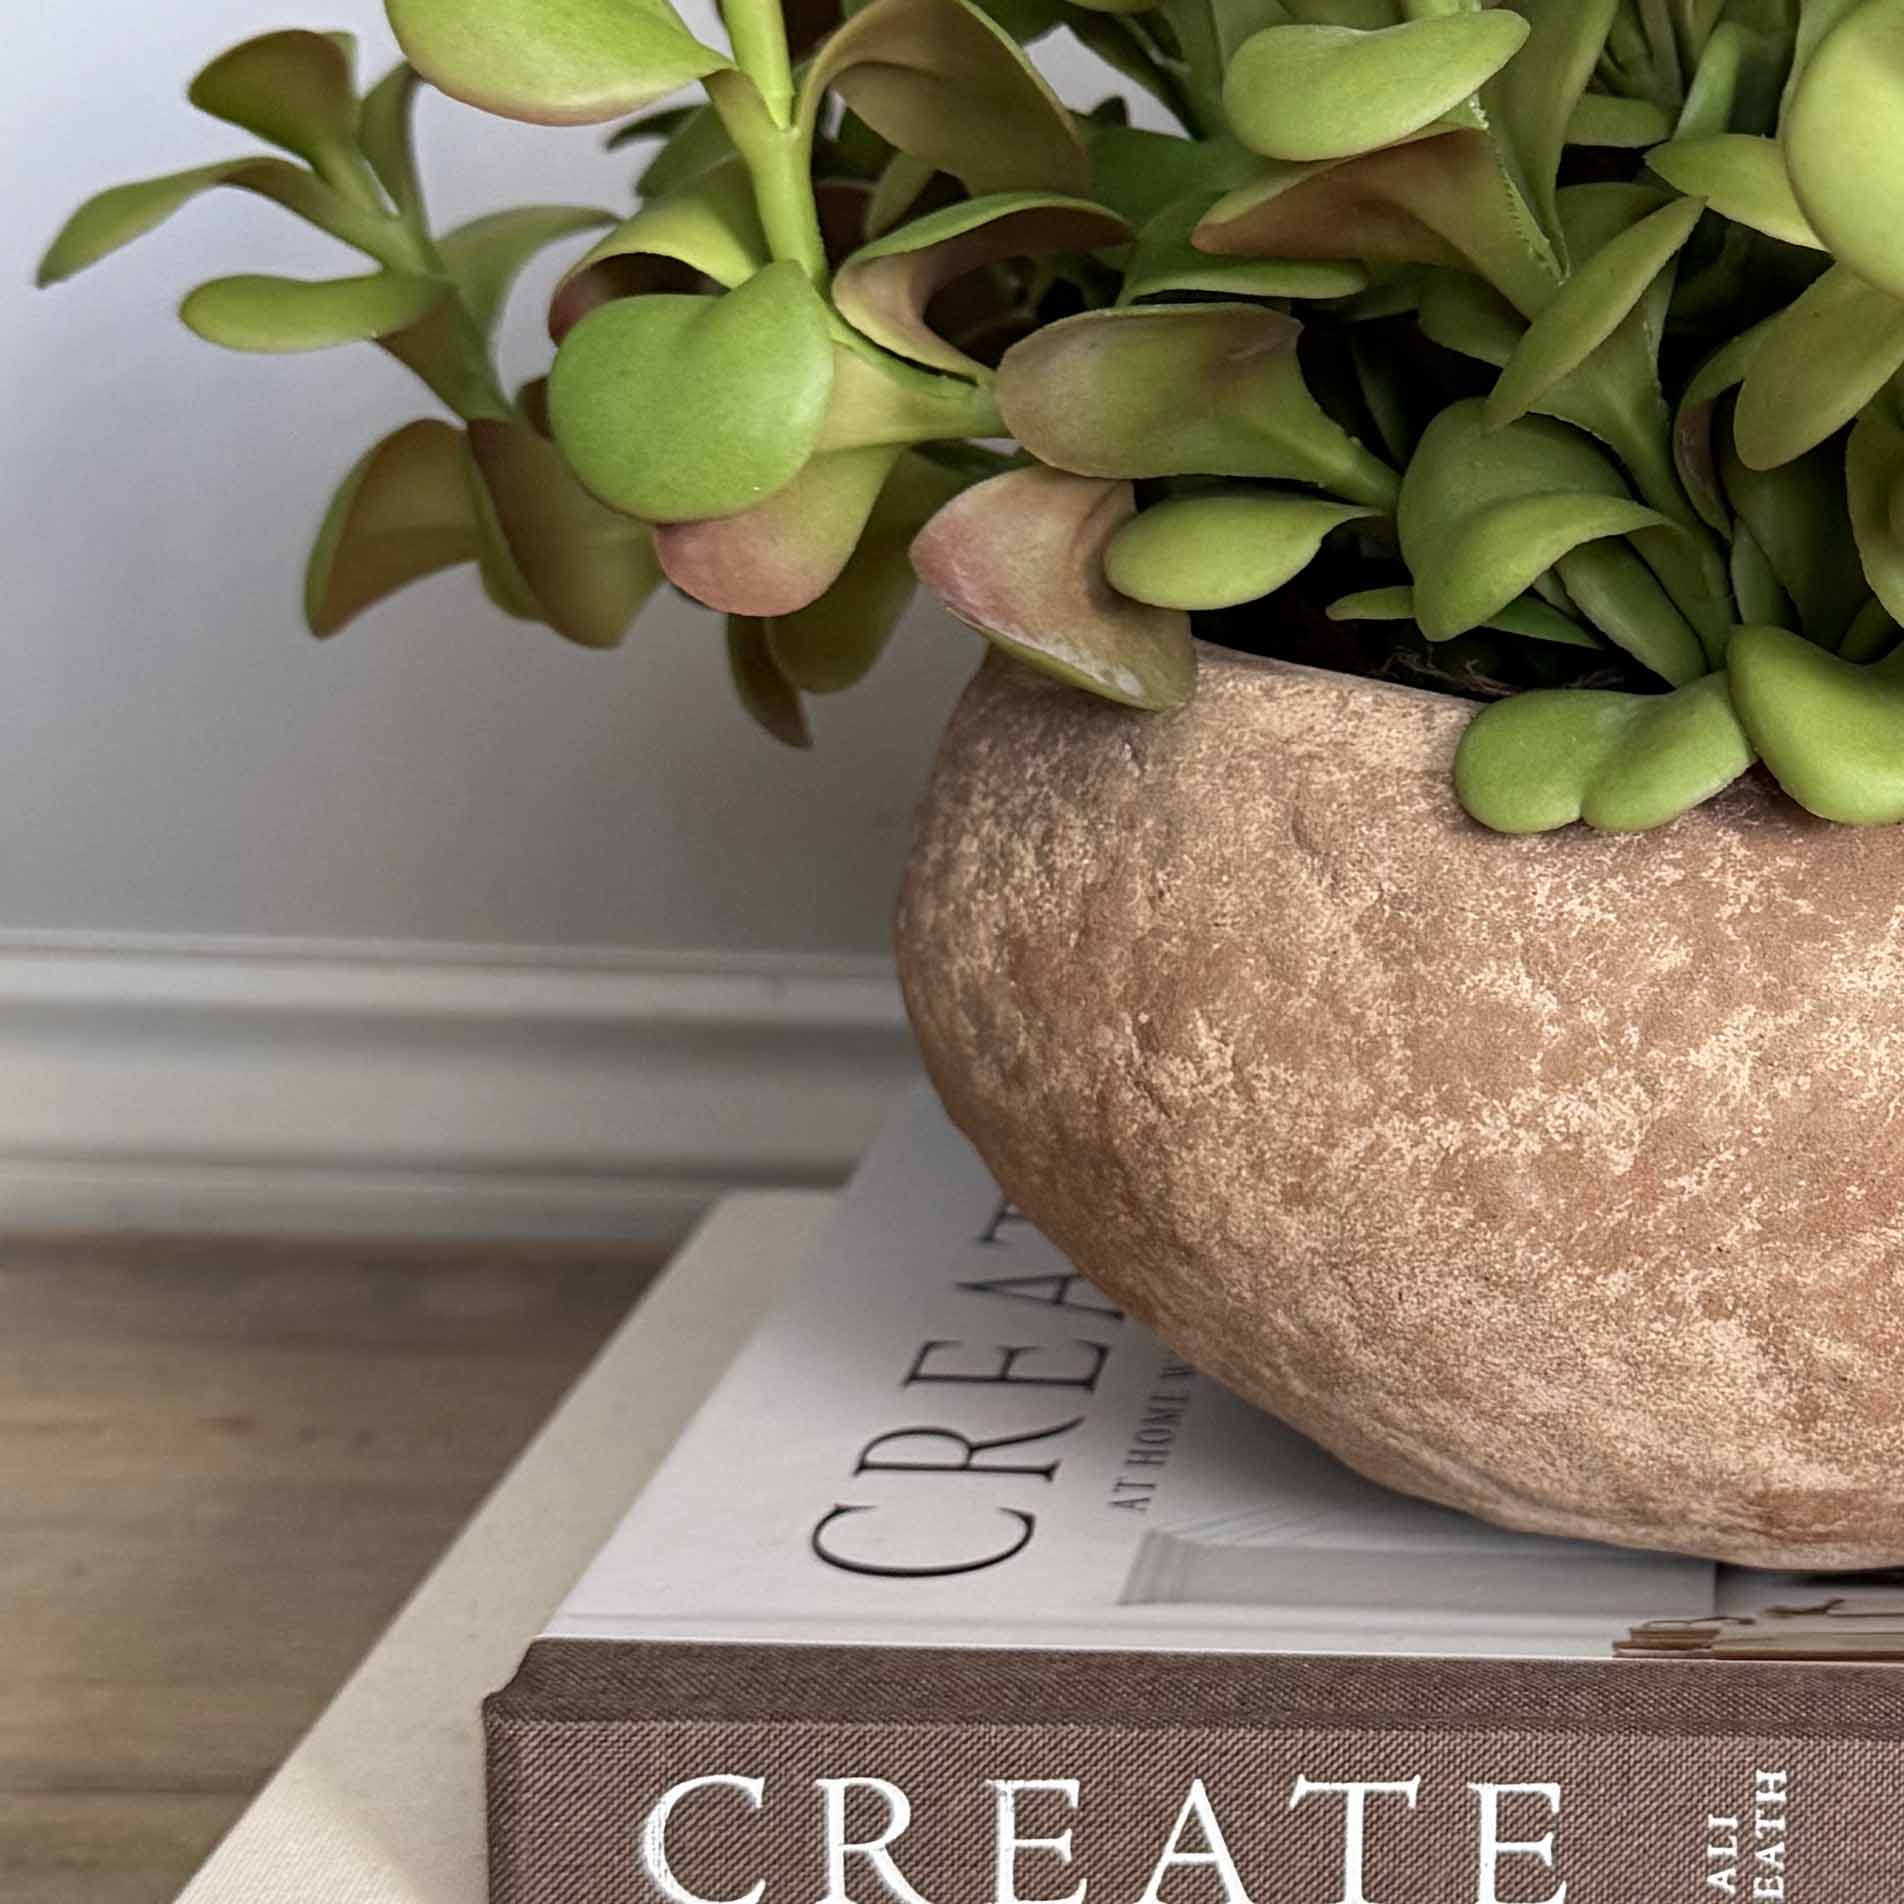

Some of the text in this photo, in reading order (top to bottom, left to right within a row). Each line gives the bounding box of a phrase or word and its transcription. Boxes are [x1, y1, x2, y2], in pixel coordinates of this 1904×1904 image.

[1124, 1390, 1190, 1468] HOME
[1108, 1475, 1157, 1513] AT
[1705, 1812, 1739, 1896] ALI
